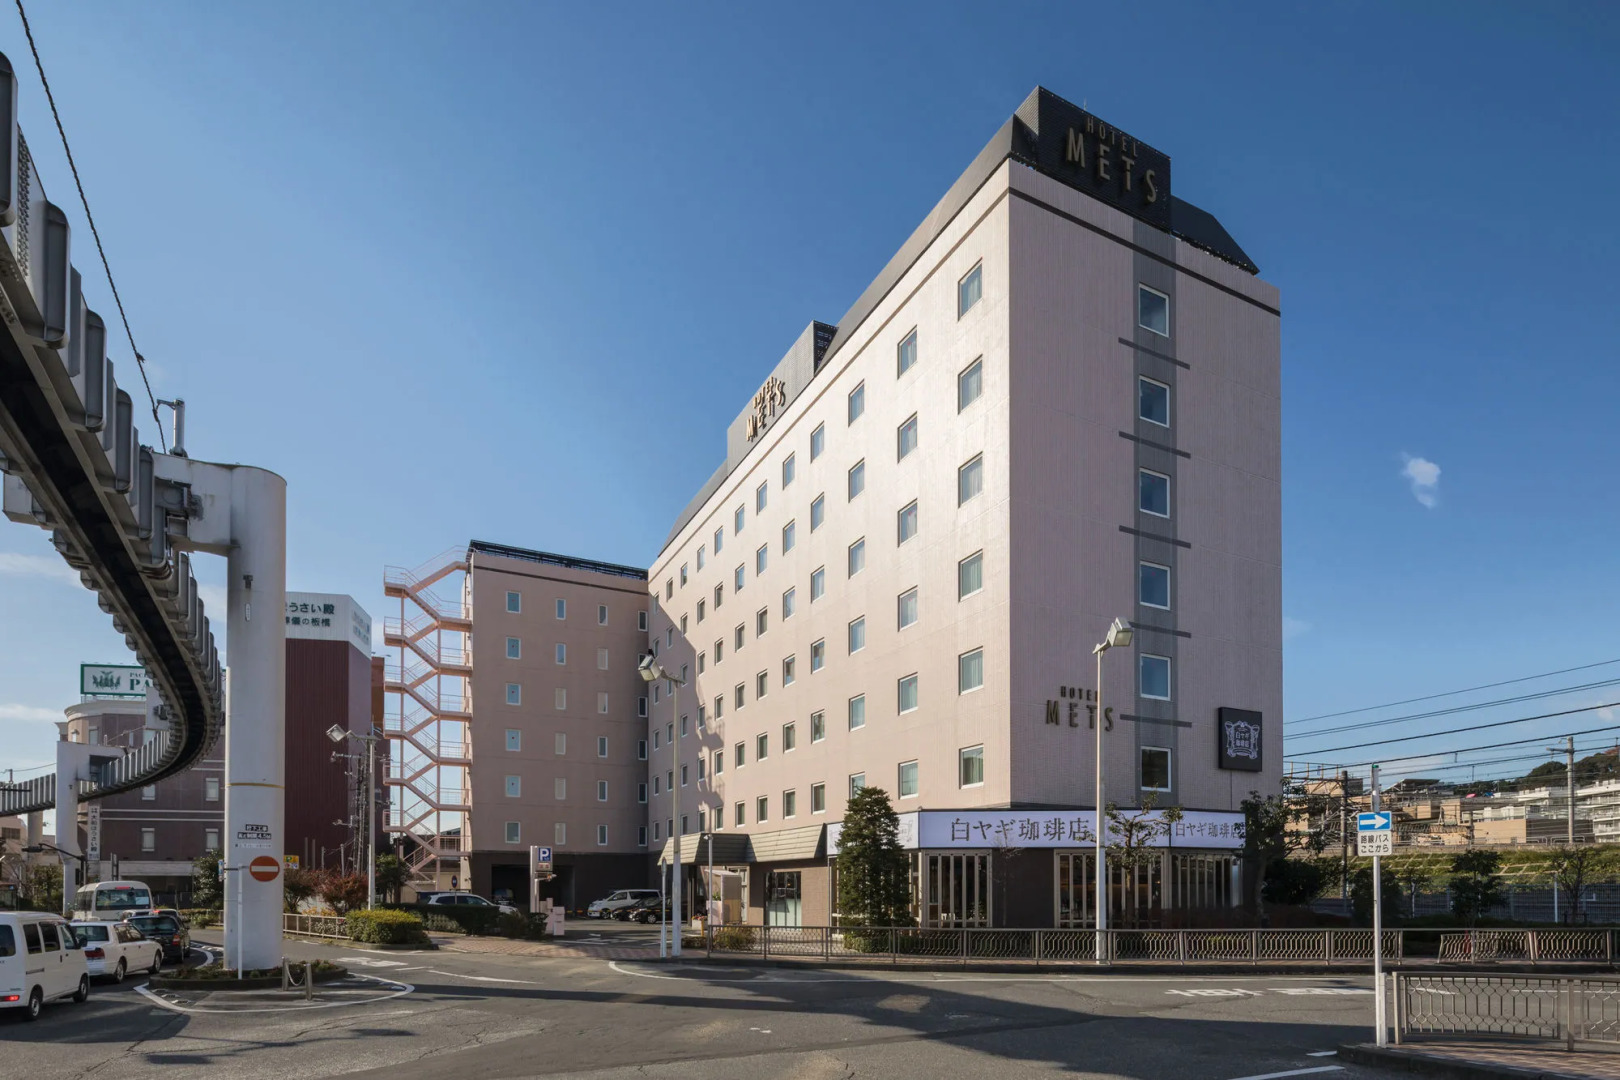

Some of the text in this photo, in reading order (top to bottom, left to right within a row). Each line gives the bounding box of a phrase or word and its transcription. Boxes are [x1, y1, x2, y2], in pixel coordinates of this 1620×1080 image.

[1087, 117, 1138, 157] HOTEL
[1066, 127, 1157, 203] METS
[746, 380, 783, 442] METS
[285, 602, 335, 614] うさい殿
[1046, 699, 1114, 731] METS
[951, 817, 1090, 842] 白ヤギ珈琲店
[1360, 834, 1389, 844] 路線バス
[540, 848, 549, 861] P
[1360, 844, 1389, 853] ここから
